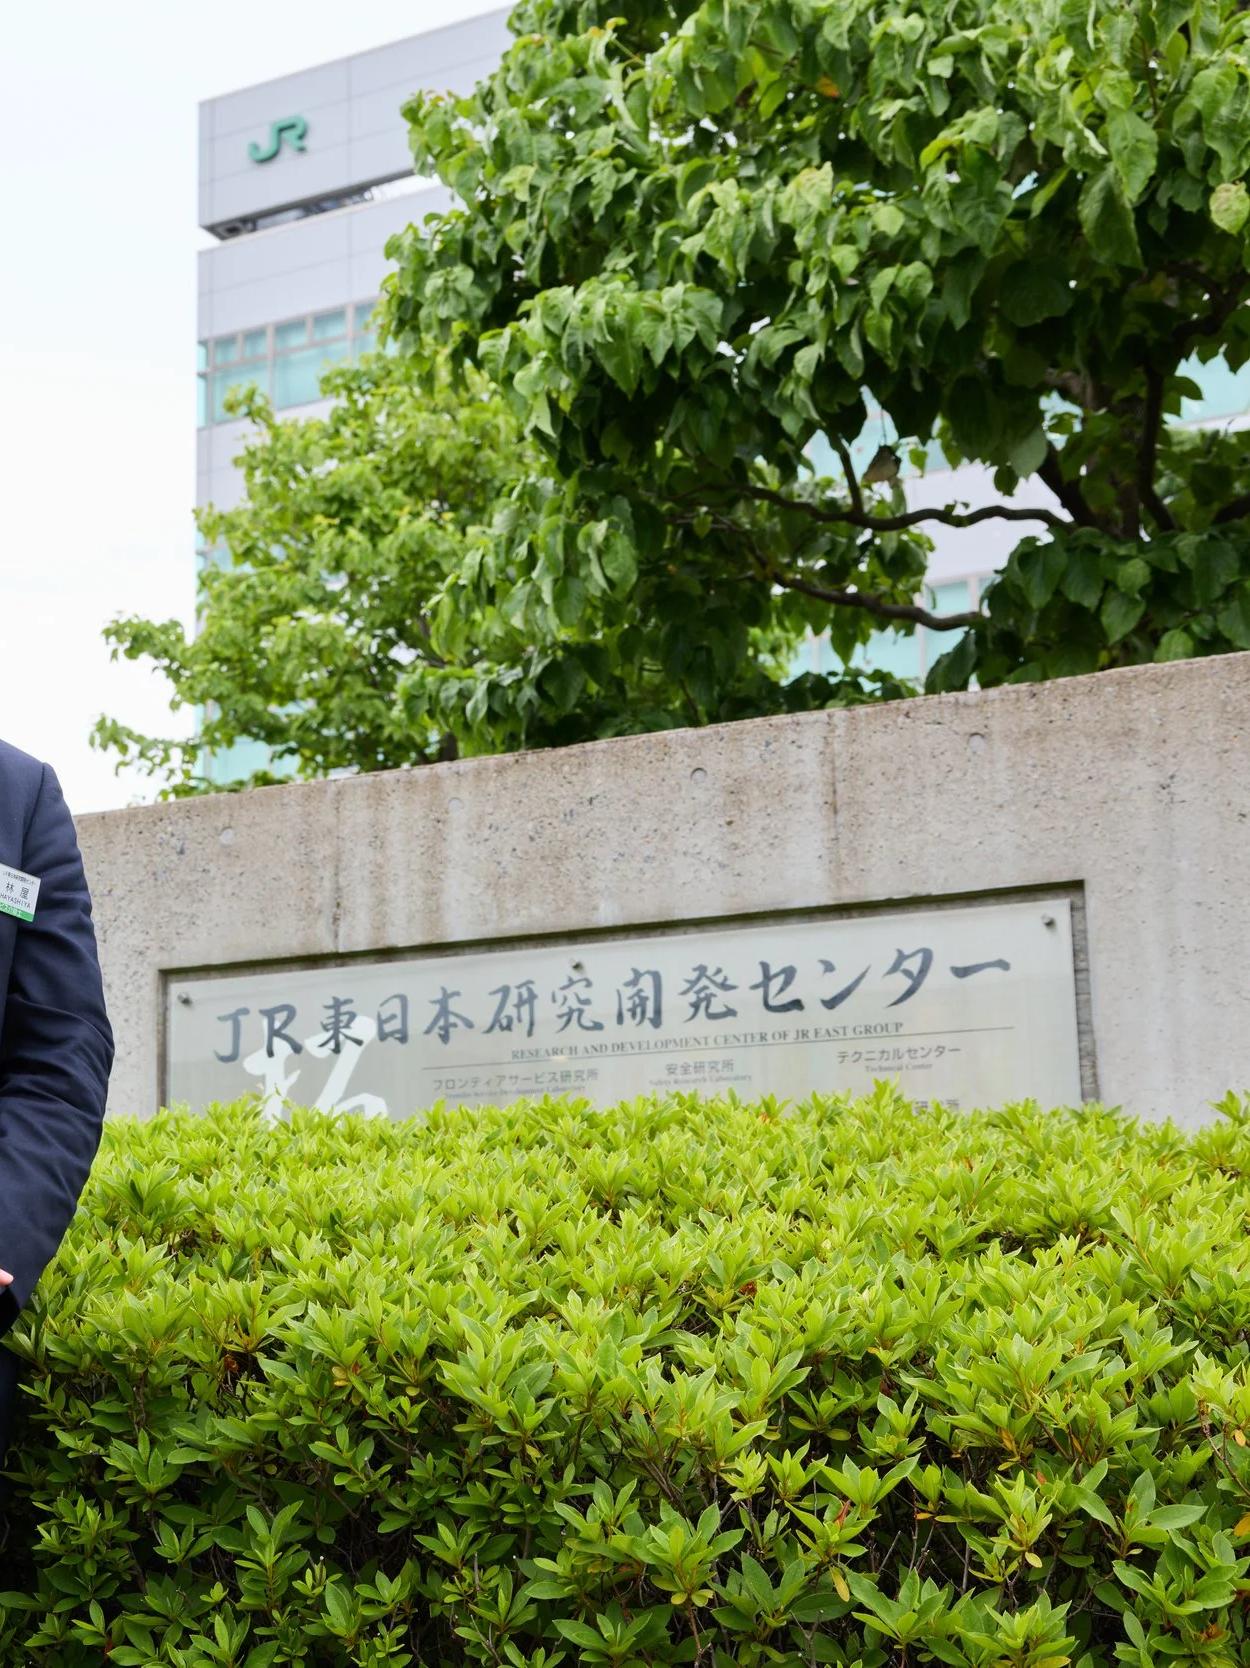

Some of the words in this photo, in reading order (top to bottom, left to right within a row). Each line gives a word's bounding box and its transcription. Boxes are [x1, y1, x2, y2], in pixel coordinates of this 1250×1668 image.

[248, 115, 308, 163] JR
[0, 892, 31, 909] HAYASHIYA
[214, 946, 1011, 1064] JR東日本研究開発センター
[511, 1045, 578, 1060] RESEARCH
[581, 1042, 609, 1054] AND
[612, 1035, 710, 1052] DEVELOPMENT
[713, 1031, 769, 1046] CENTER
[771, 1030, 790, 1041] OF
[793, 1028, 810, 1040] JR
[813, 1025, 850, 1038] EAST
[852, 1021, 904, 1036] GROUP
[837, 1045, 961, 1064] テクニカルセンター
[433, 1068, 598, 1092] フロンティアサービス研究所
[665, 1059, 734, 1077] 安全研究所
